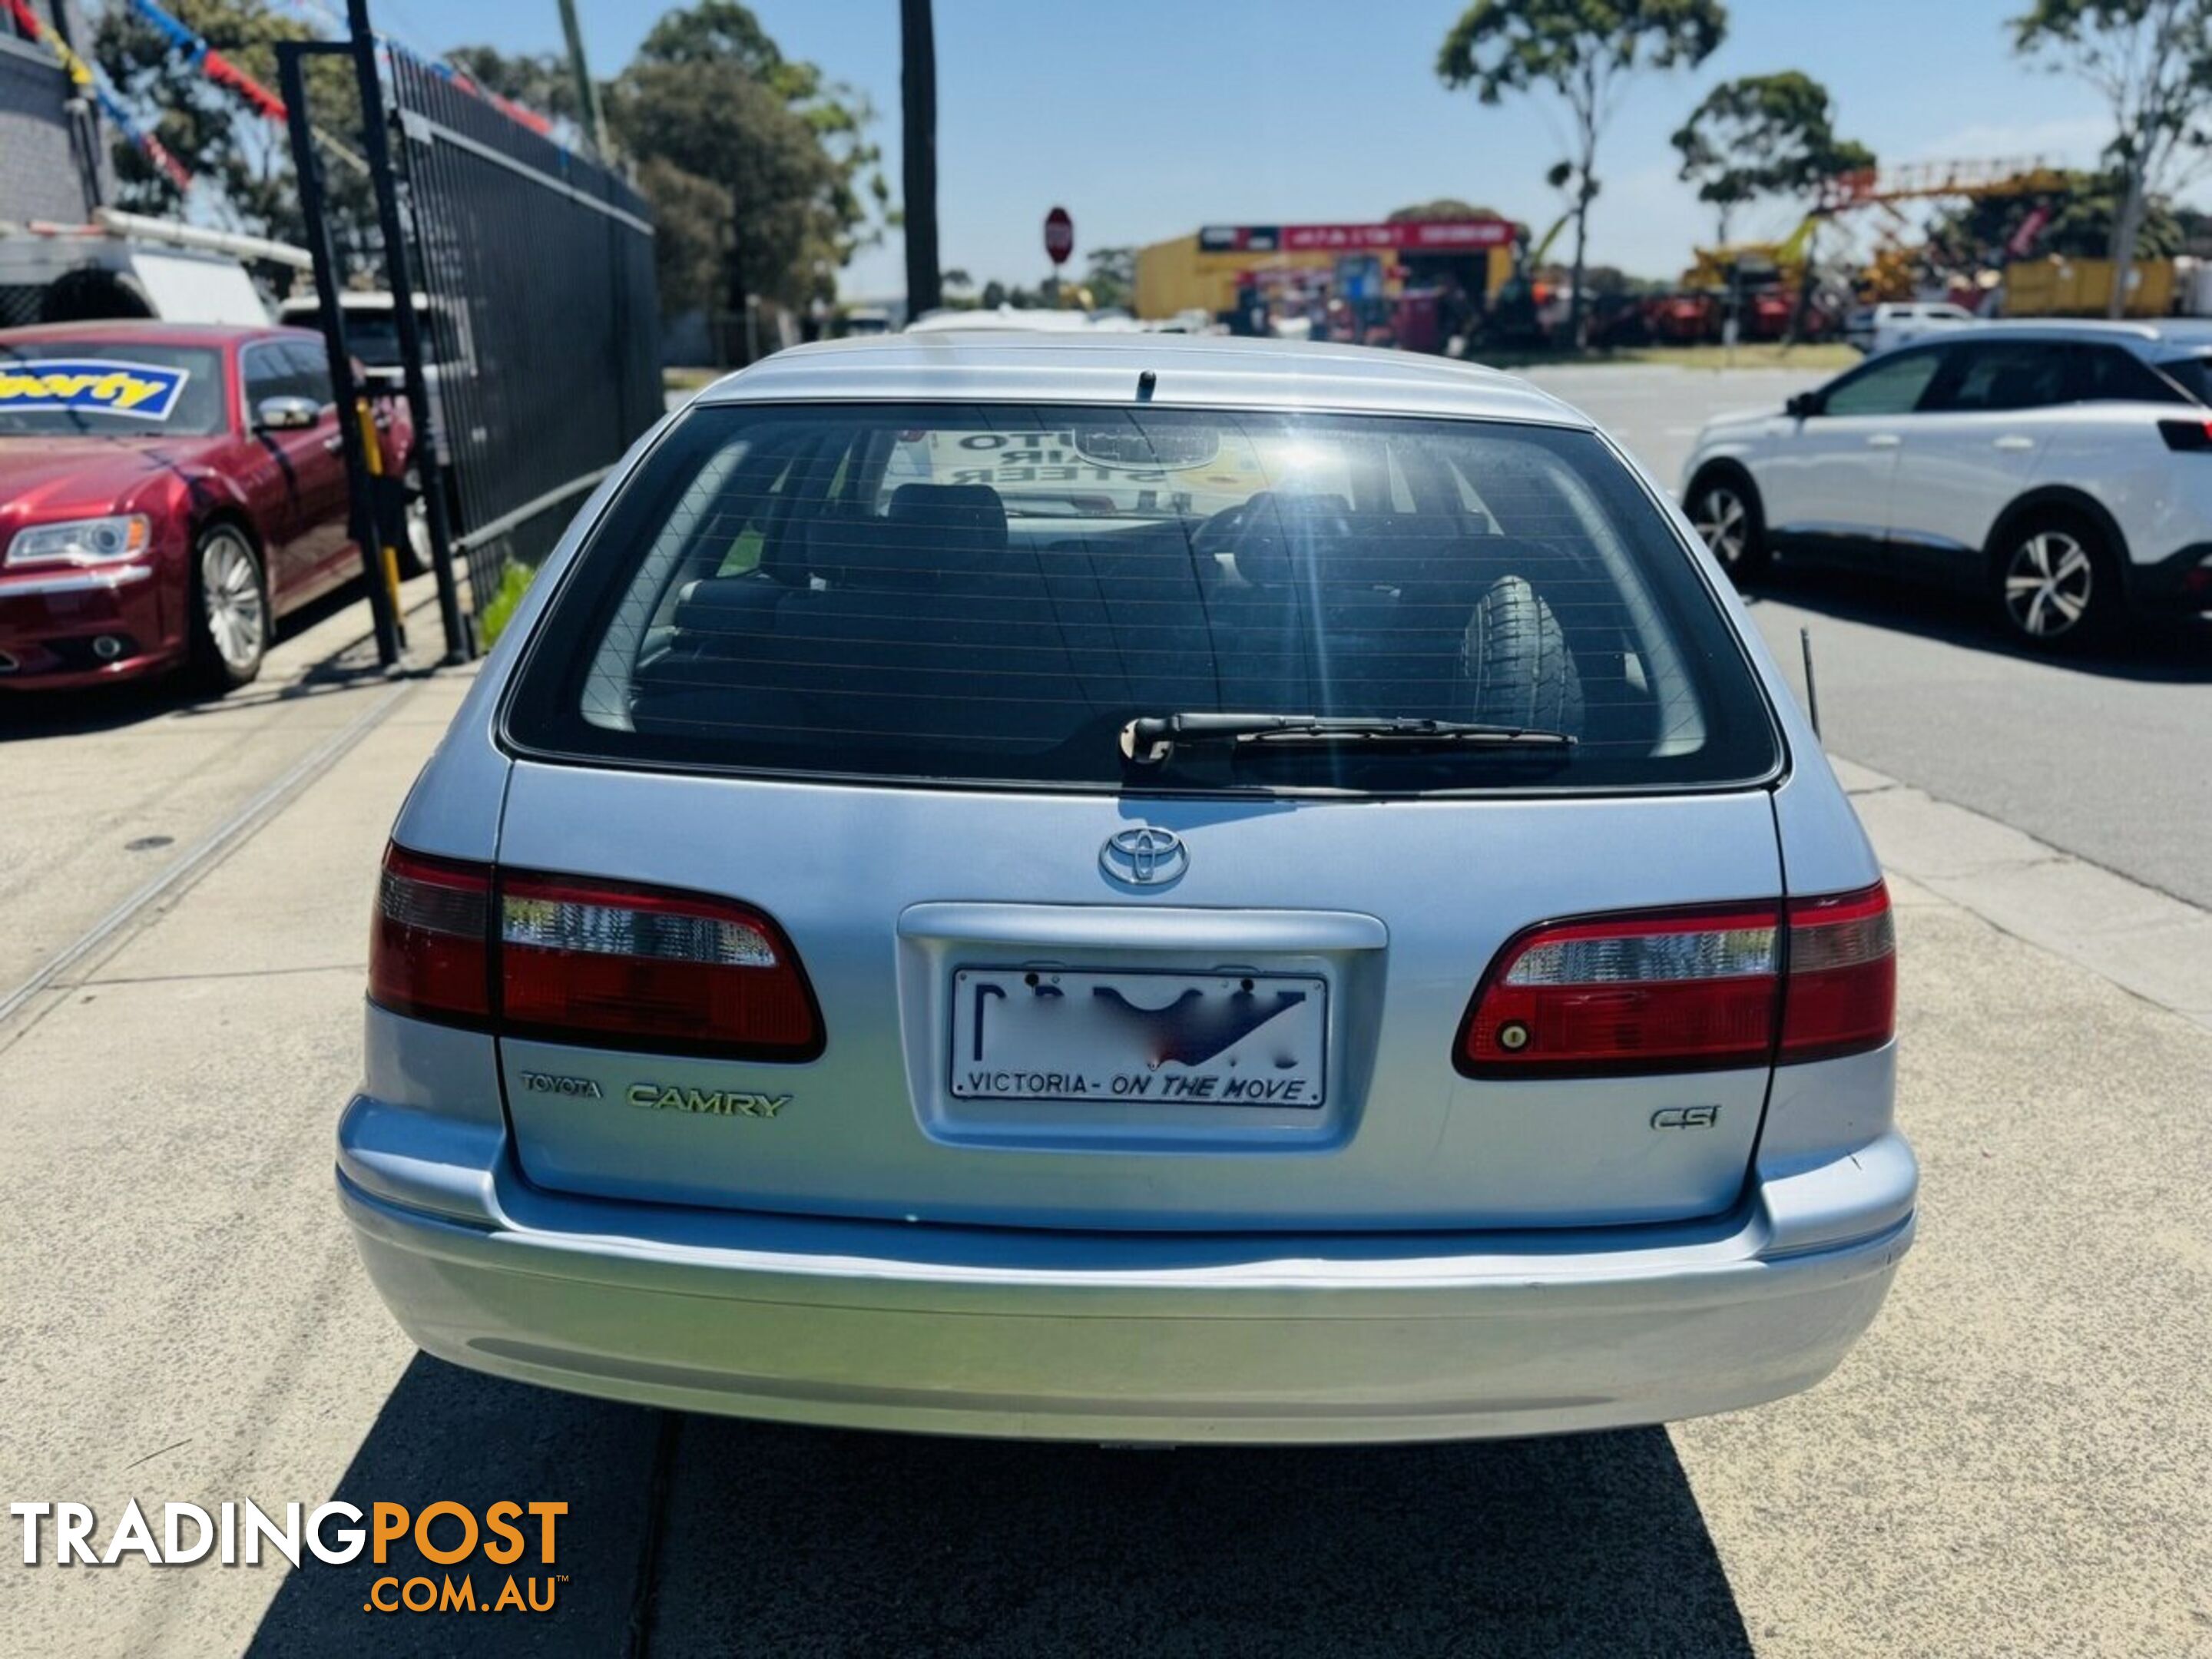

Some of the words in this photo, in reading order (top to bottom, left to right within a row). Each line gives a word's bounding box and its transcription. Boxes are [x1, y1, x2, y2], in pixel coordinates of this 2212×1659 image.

[521, 1071, 603, 1099] TOYOTA
[627, 1084, 793, 1118] CAMRY
[1111, 1076, 1153, 1094] ON
[1161, 1076, 1219, 1098] THE
[1223, 1078, 1306, 1101] MOVE
